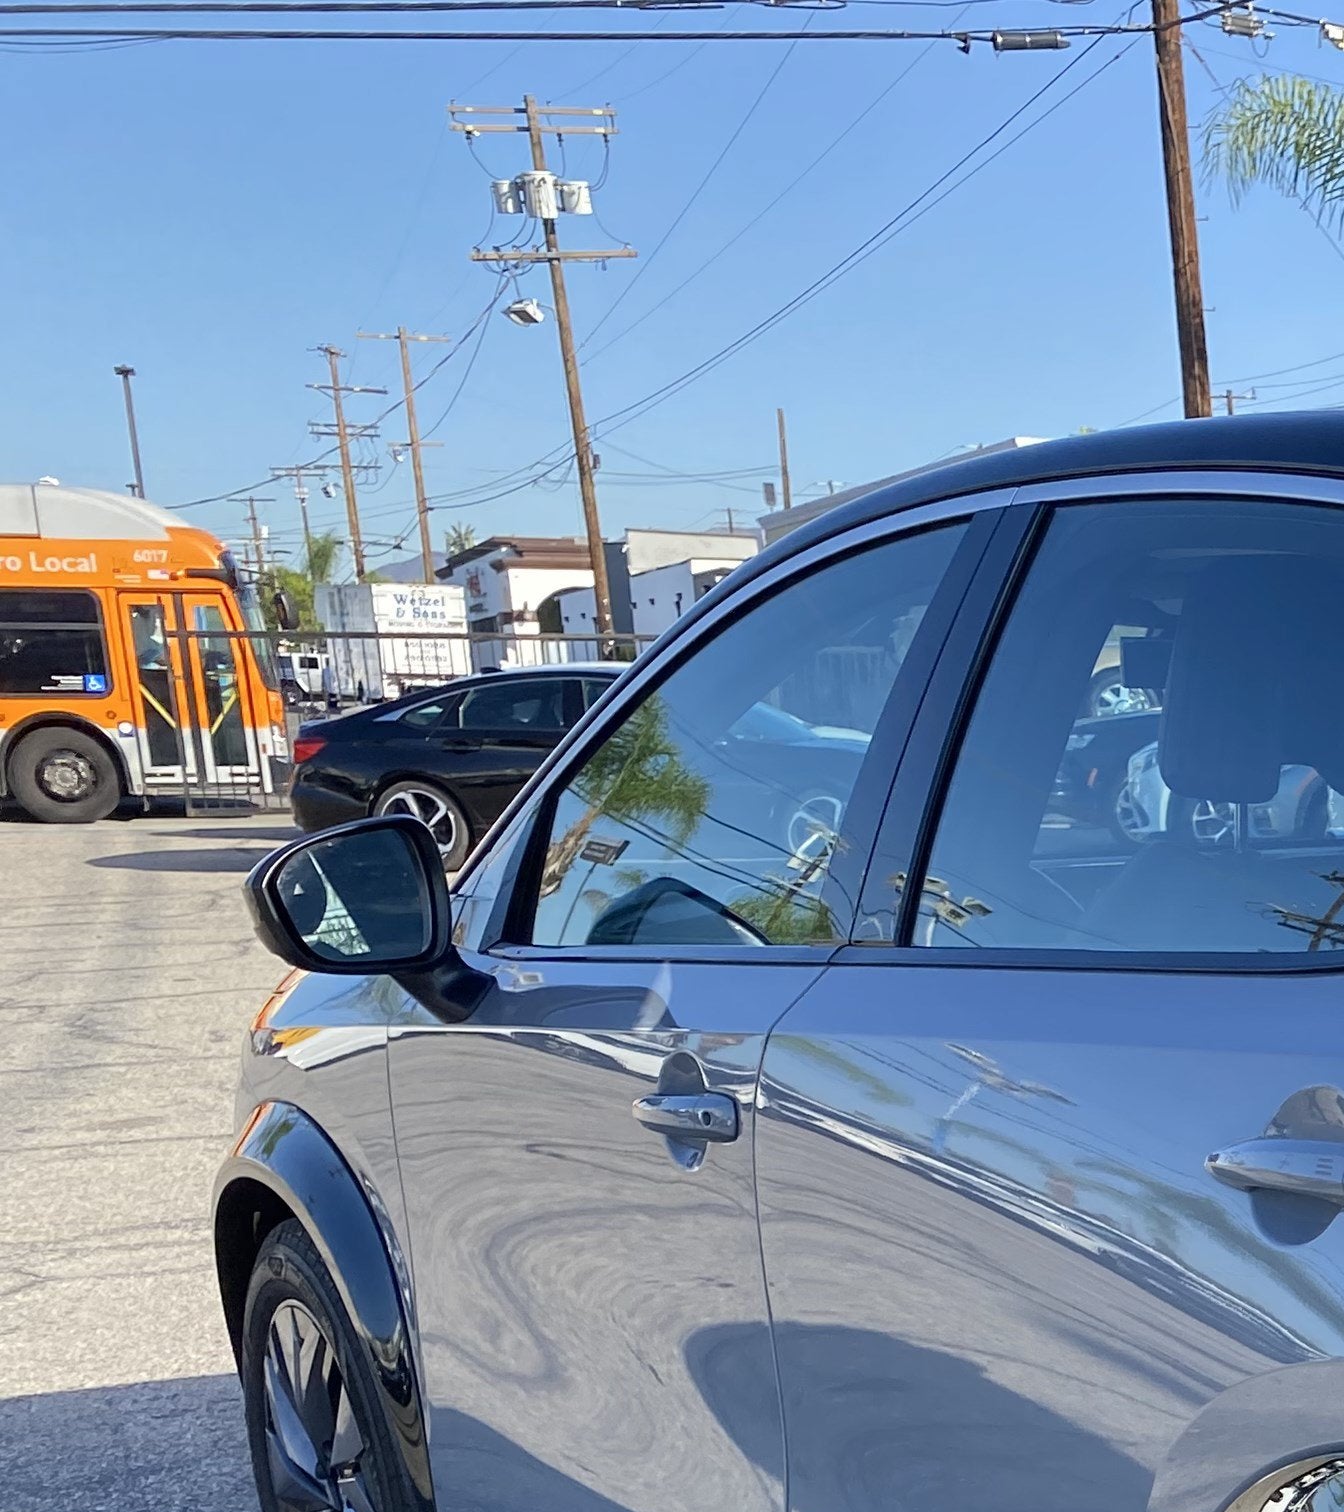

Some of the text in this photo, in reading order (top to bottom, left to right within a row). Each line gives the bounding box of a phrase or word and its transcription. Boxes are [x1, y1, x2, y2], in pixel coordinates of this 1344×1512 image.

[29, 551, 98, 573] Local
[132, 549, 168, 563] 6017
[393, 593, 446, 606] Wetzel
[412, 606, 446, 619] Sons
